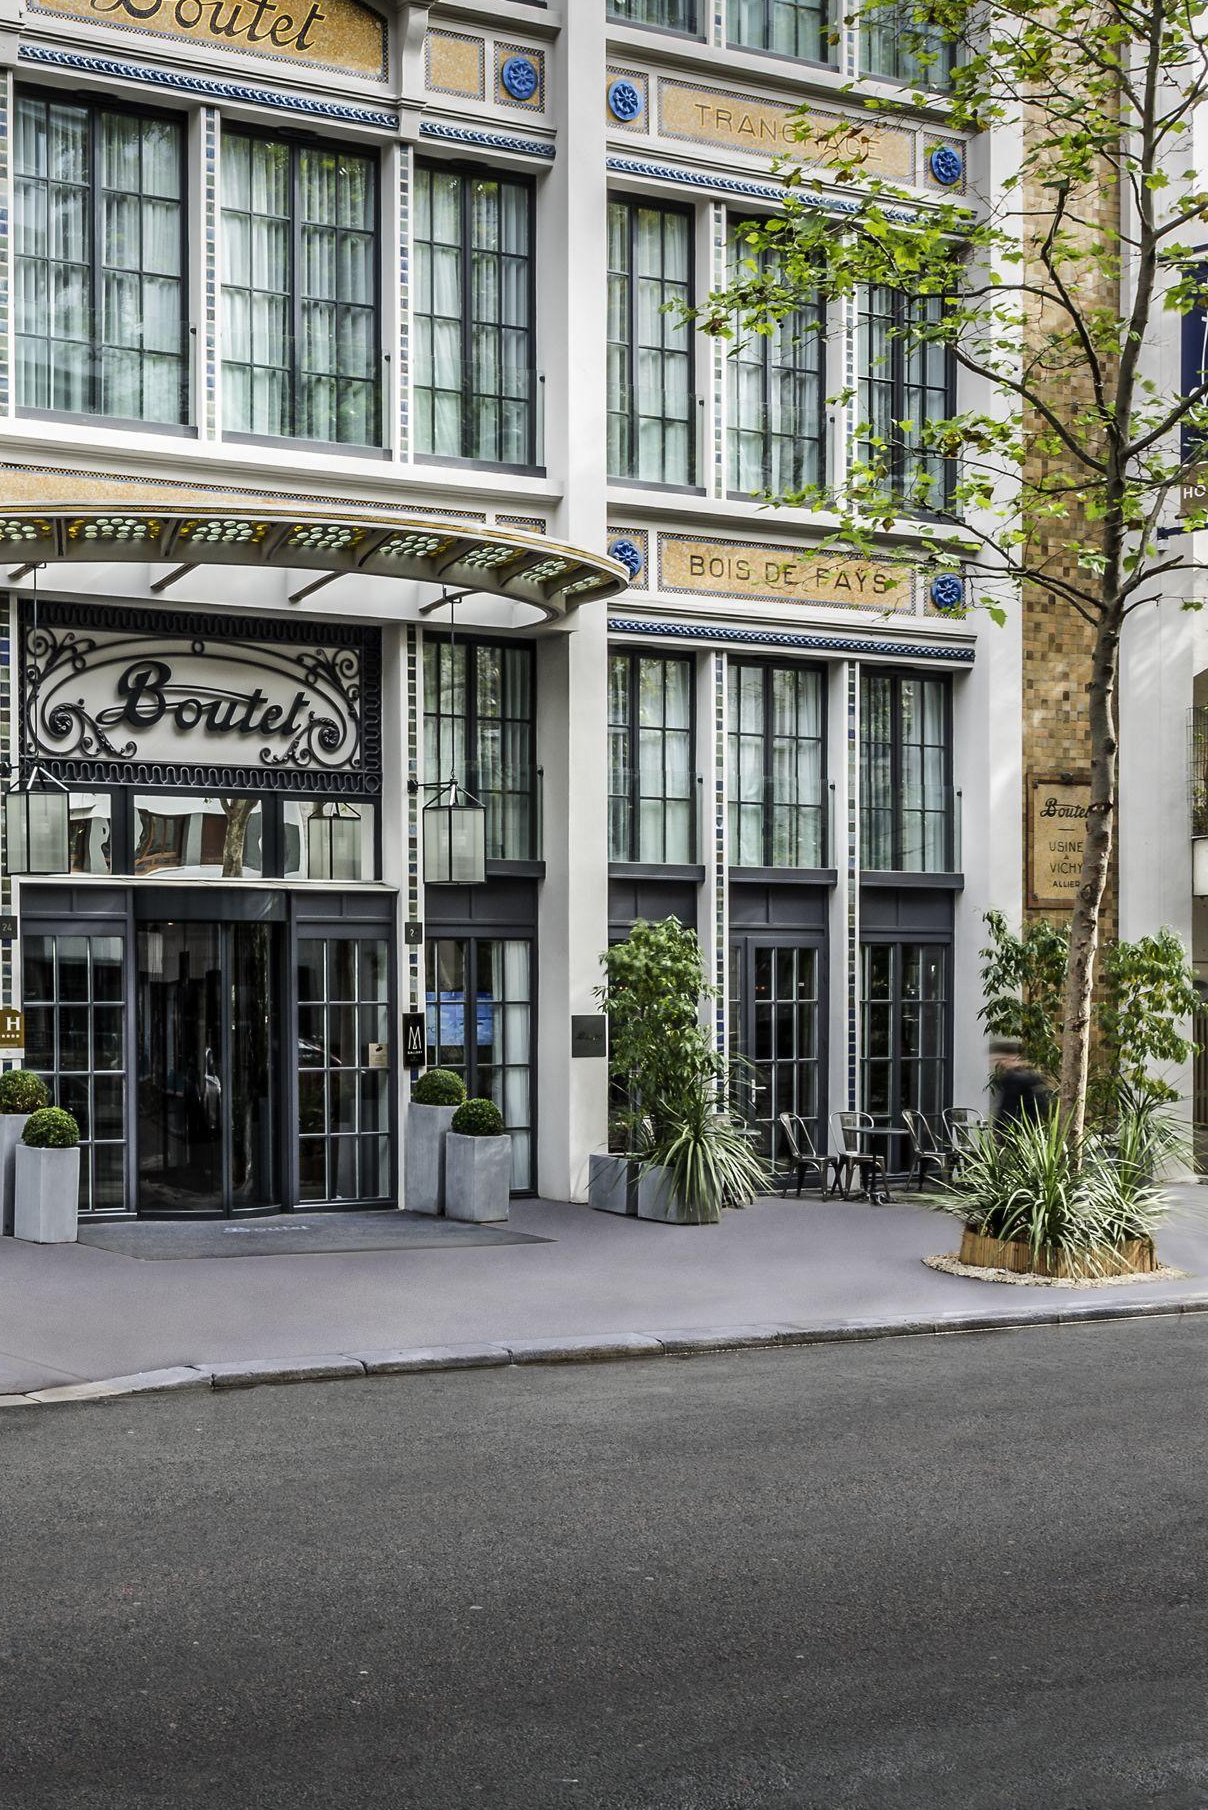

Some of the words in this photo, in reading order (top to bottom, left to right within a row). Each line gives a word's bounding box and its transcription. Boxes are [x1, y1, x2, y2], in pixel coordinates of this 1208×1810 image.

[690, 555, 750, 580] BOIS
[765, 563, 797, 585] DE
[95, 660, 311, 736] Boutet
[1049, 842, 1084, 852] USINE
[1050, 863, 1084, 874] VICHY
[1, 923, 12, 932] 24
[5, 1016, 21, 1031] H
